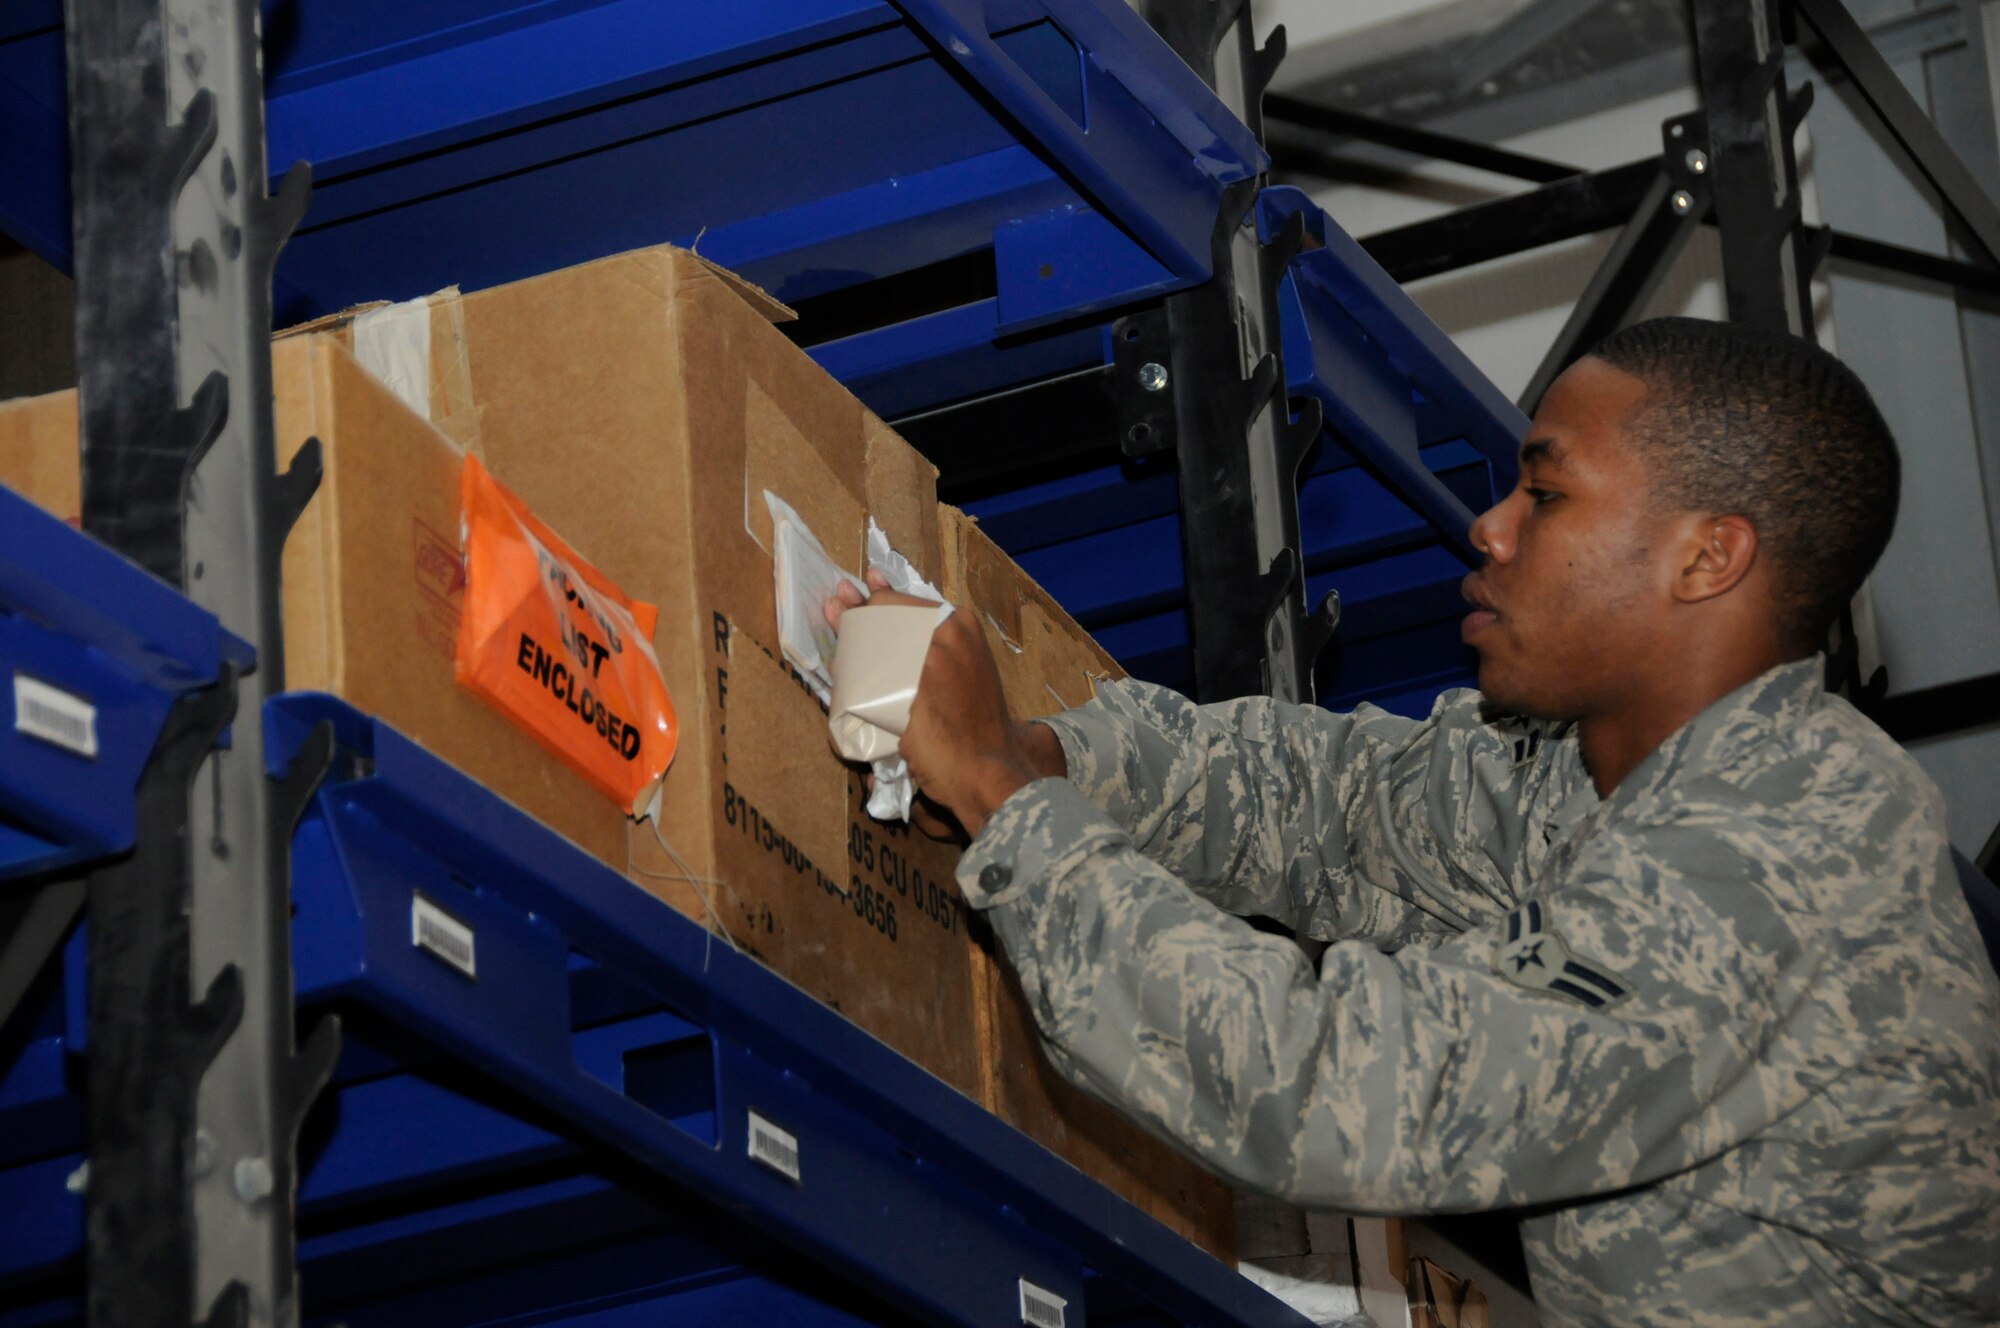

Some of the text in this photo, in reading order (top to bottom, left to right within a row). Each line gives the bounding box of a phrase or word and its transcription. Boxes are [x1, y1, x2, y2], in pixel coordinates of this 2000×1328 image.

[560, 612, 610, 679] LIST
[517, 632, 641, 762] ENCLOSED
[880, 844, 907, 897] CU
